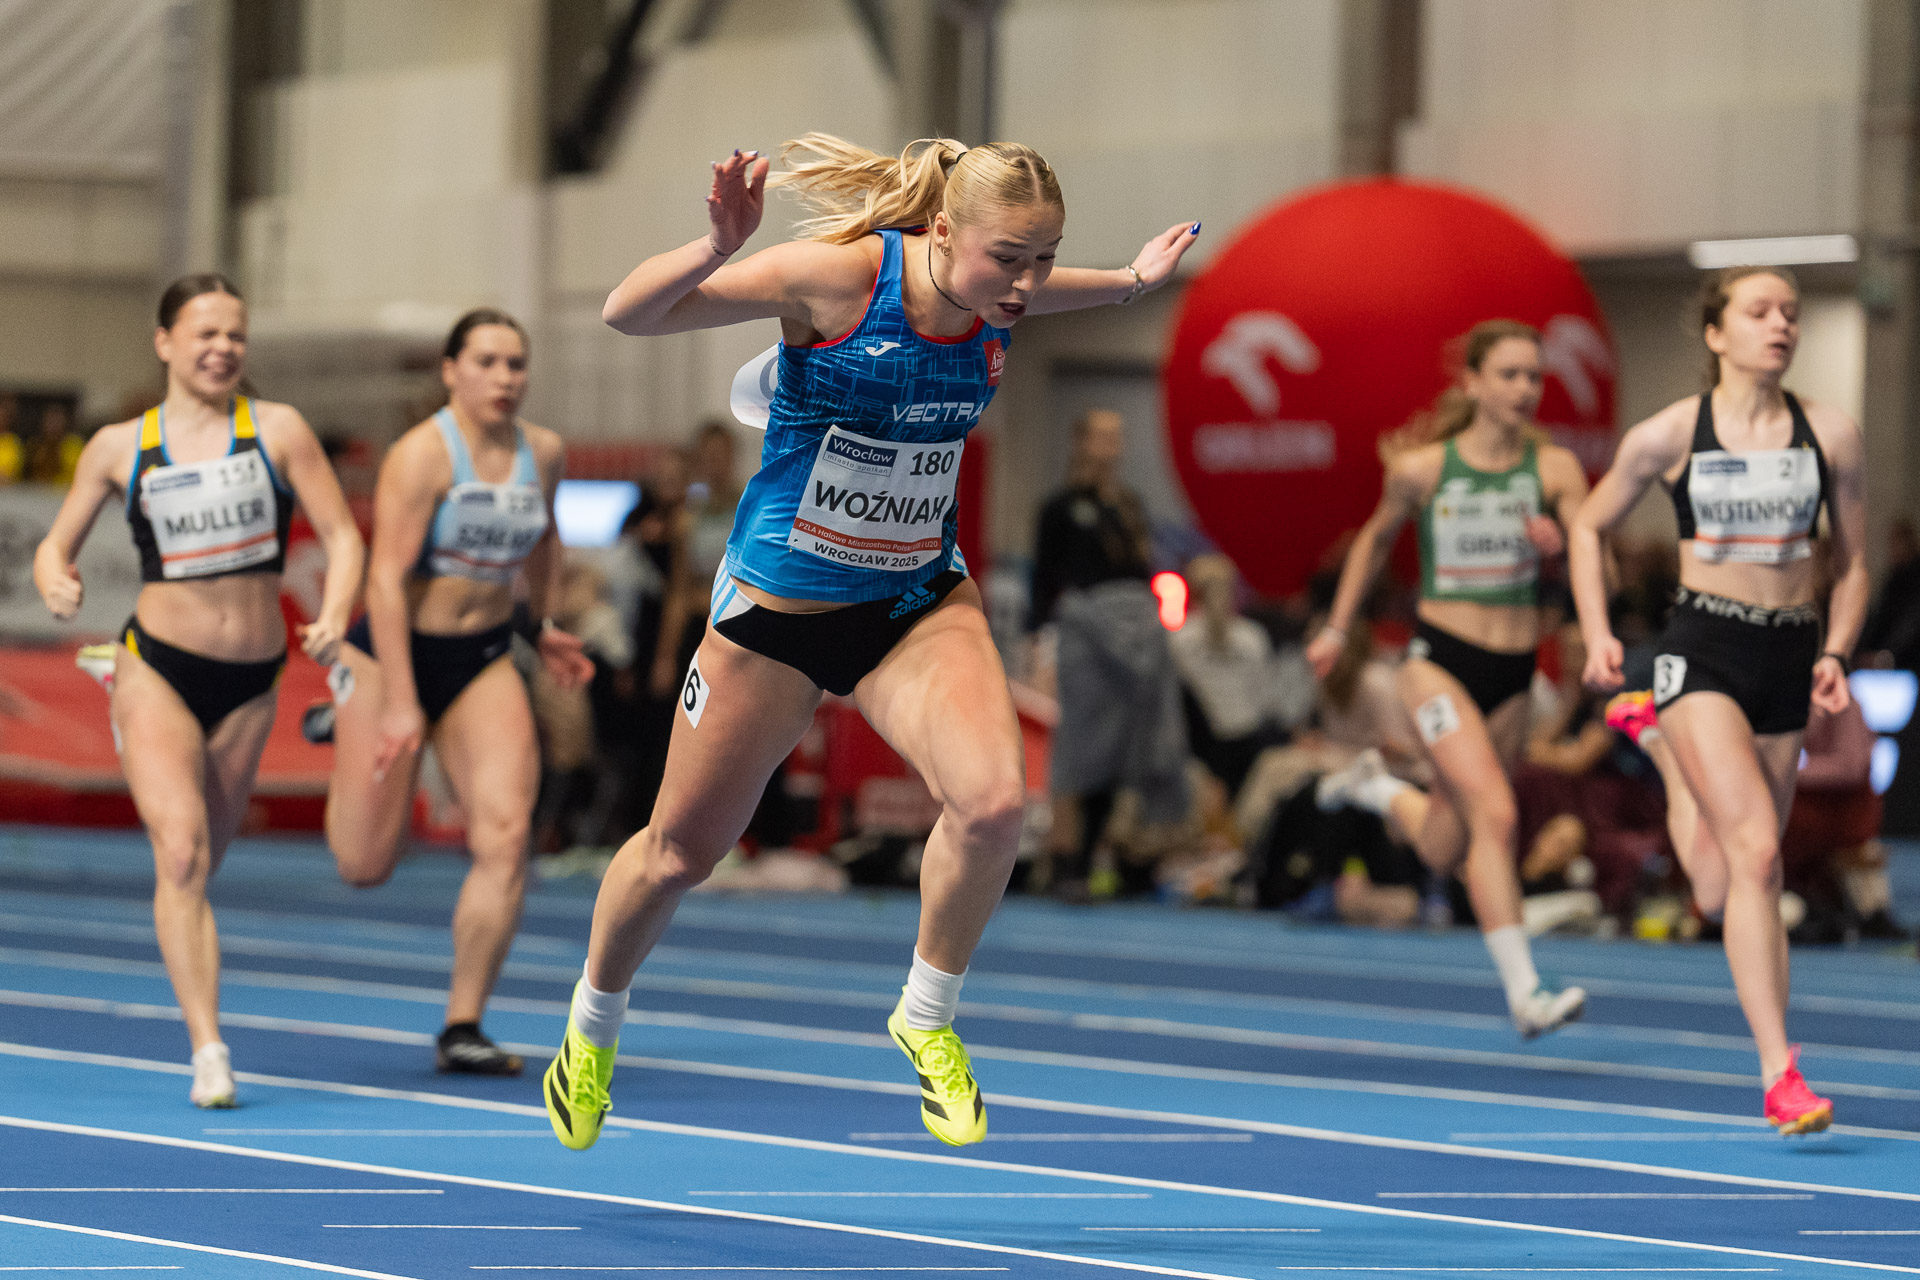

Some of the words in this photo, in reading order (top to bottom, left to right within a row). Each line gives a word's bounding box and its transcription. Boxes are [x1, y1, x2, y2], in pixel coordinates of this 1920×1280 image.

[892, 401, 985, 423] VECTRA
[833, 438, 894, 463] Wrocław
[909, 450, 955, 476] 180
[827, 454, 855, 468] miasto
[857, 464, 889, 475] spotkań
[814, 479, 949, 525] WOŹNIAK
[165, 498, 266, 538] MULLER
[817, 529, 847, 544] Halowe
[848, 539, 891, 550] Mistrzostwa
[814, 541, 889, 566] WROCŁAW
[890, 555, 919, 568] 2025
[889, 592, 937, 619] adidas
[1692, 593, 1769, 627] NIKE
[684, 667, 701, 712] 6
